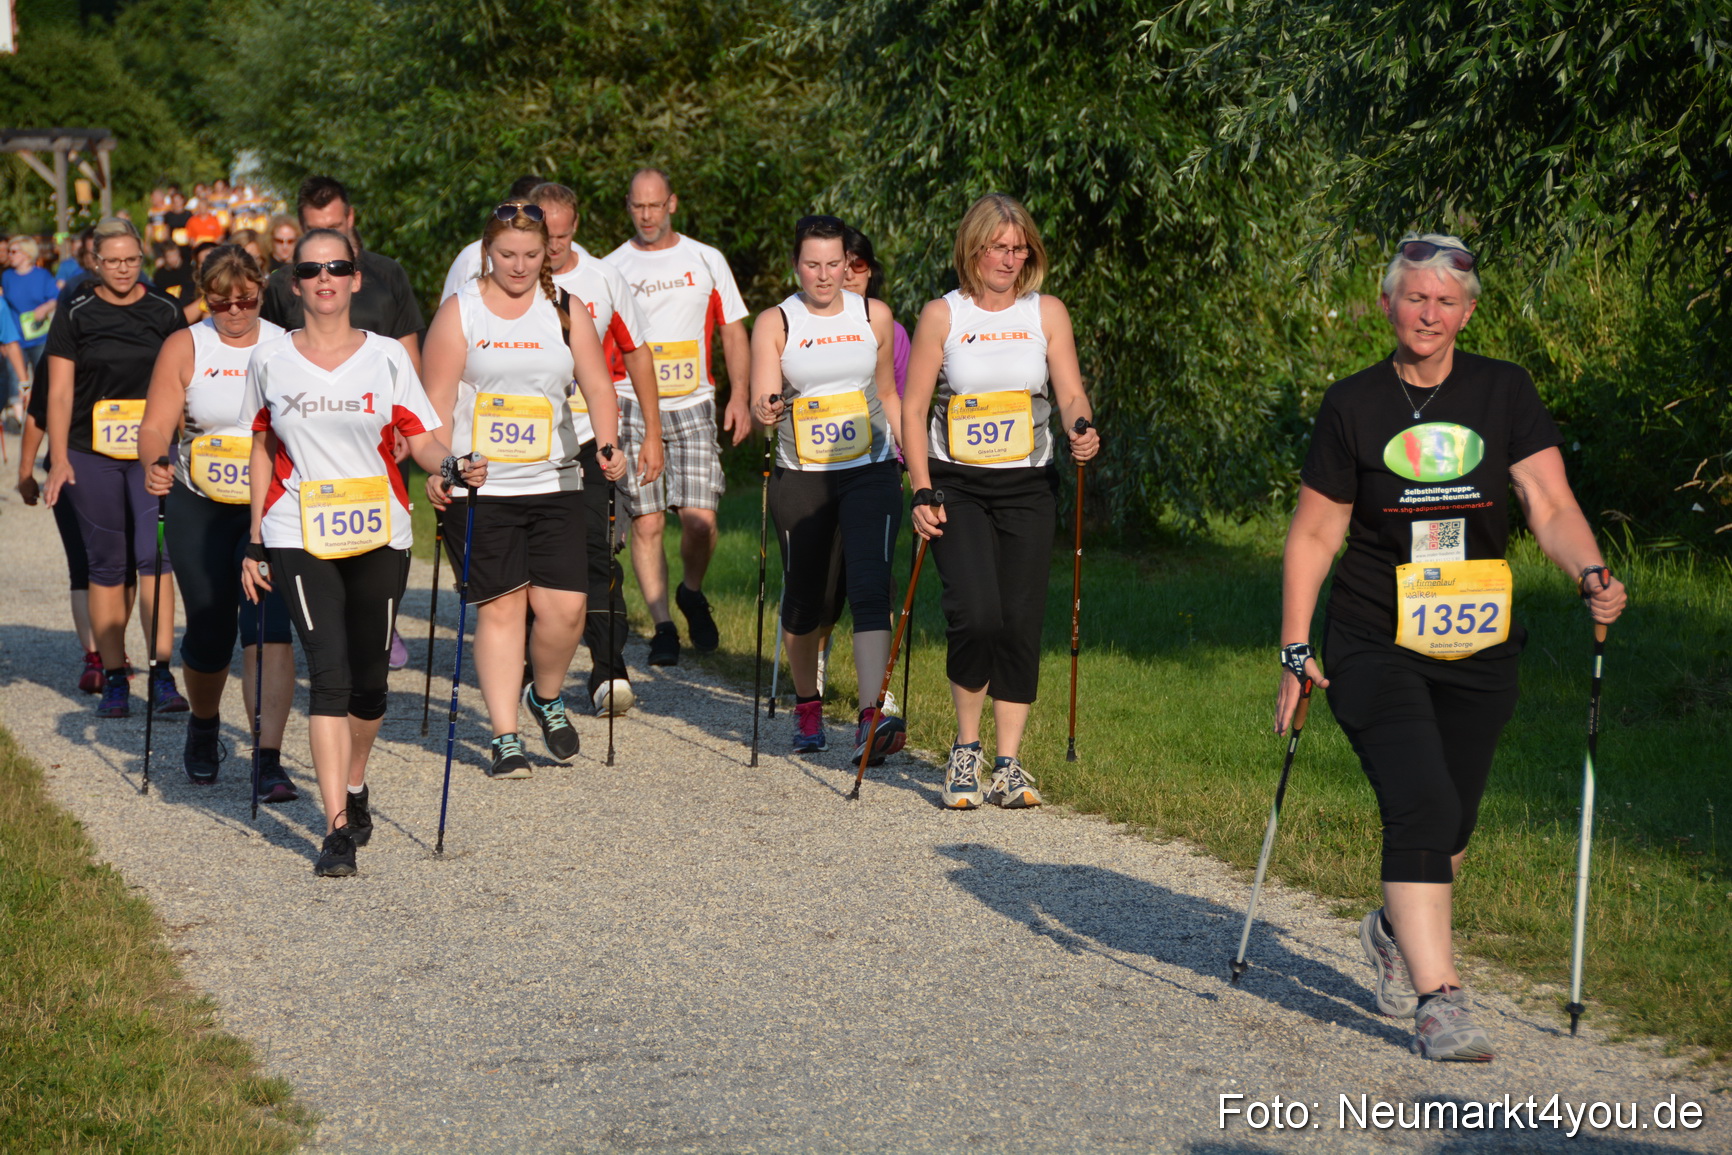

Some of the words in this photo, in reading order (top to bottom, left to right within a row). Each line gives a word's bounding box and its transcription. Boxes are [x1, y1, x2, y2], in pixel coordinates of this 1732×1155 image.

[630, 271, 695, 297] Xplus1
[816, 334, 865, 346] KLEBL
[980, 331, 1033, 341] KLEBL
[493, 341, 544, 350] KLEBL
[658, 362, 694, 381] 513
[280, 391, 376, 418] Xplus1
[102, 425, 140, 443] 123
[489, 422, 536, 445] 594
[811, 420, 856, 445] 596
[966, 419, 1015, 446] 597
[207, 462, 251, 486] 595
[1399, 492, 1481, 503] Adipositas-Neumarkt
[1404, 486, 1475, 496] Selbsthilfegruppe-
[1383, 501, 1494, 513] www.shg-adipositas-neumarkt.de
[313, 508, 382, 537] 1505
[1416, 578, 1456, 587] firmenlauf
[1405, 591, 1437, 599] walken
[1412, 602, 1499, 636] 1352
